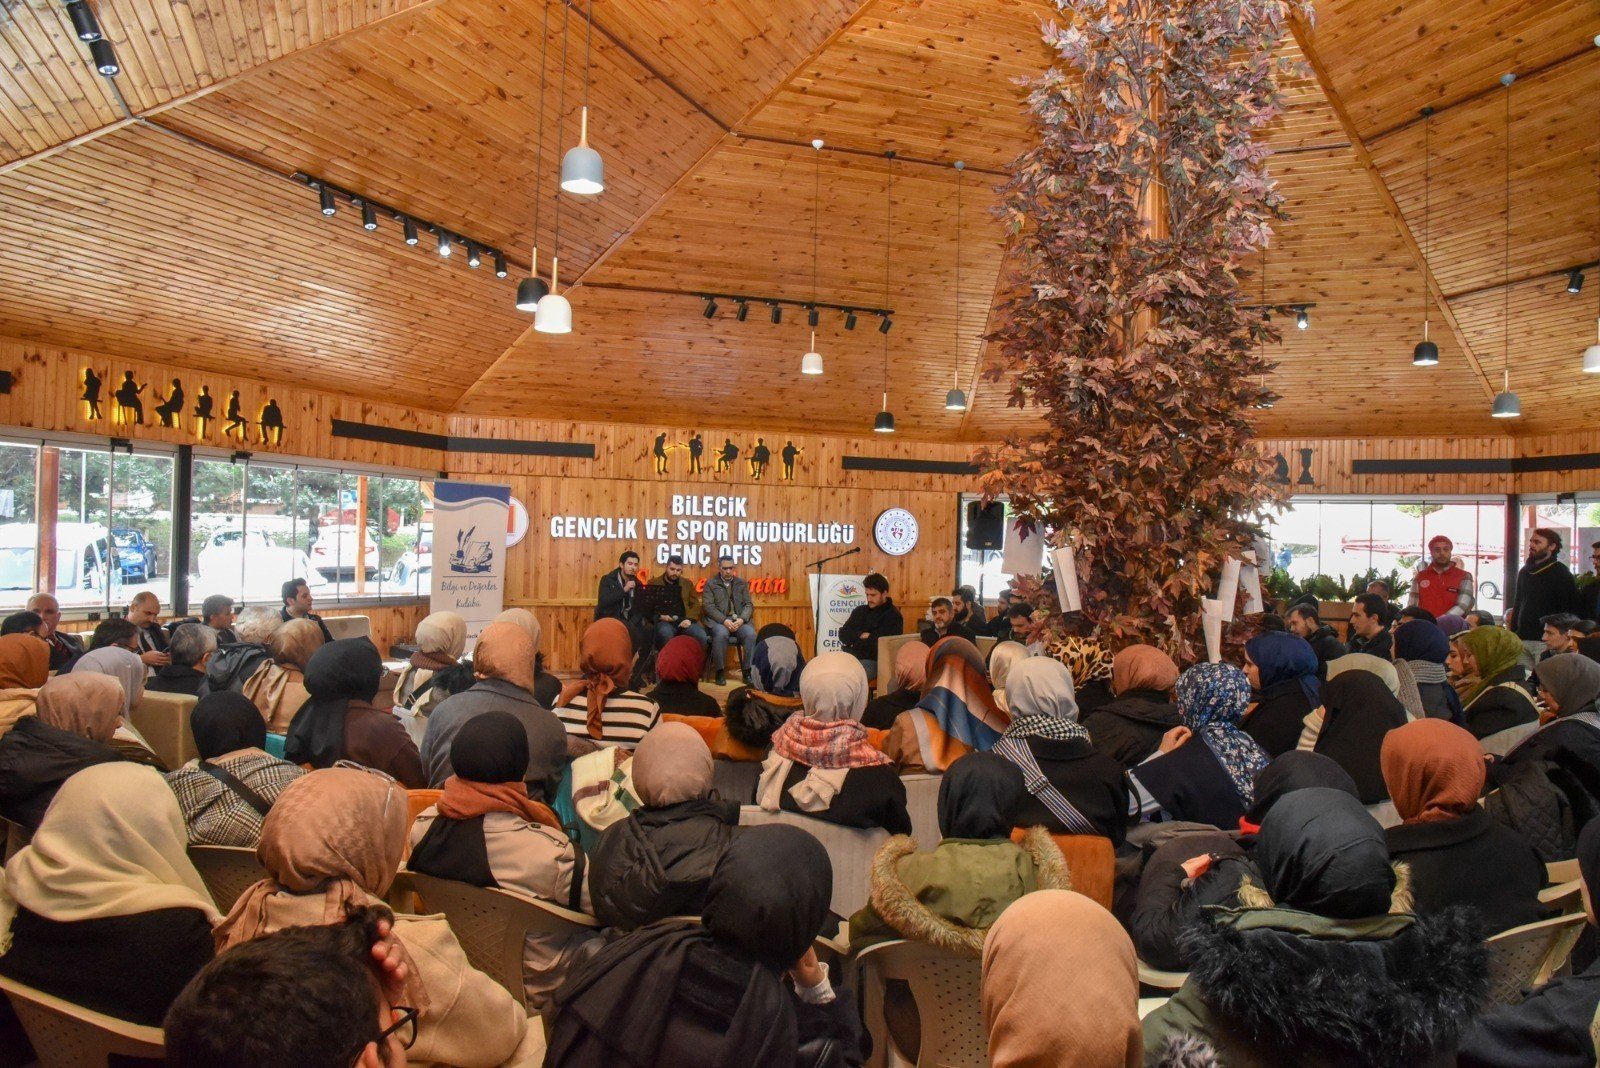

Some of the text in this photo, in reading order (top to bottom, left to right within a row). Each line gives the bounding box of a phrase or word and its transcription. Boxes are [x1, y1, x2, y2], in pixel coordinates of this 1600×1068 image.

[671, 494, 748, 518] BİLECİK
[550, 516, 855, 544] GENÇLİK VE SPOR MÜDÜRLÜĞÜ
[656, 543, 711, 567] GENÇ
[441, 580, 458, 594] Bilgi
